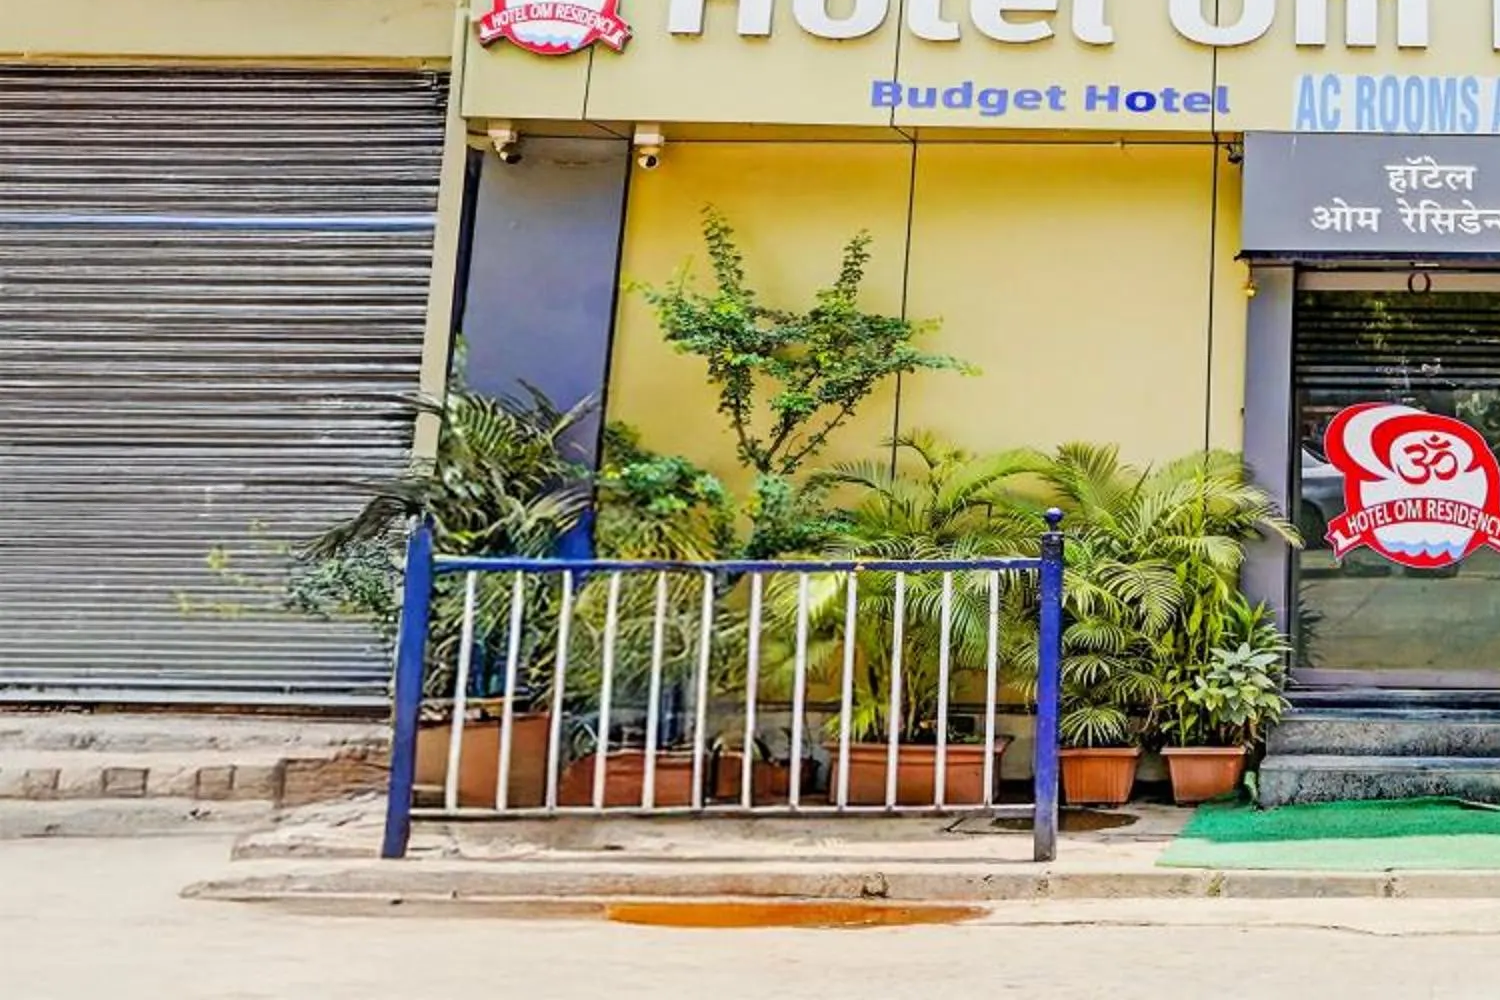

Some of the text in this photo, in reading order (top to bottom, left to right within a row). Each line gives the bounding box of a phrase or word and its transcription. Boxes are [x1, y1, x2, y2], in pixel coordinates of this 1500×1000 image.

[491, 3, 616, 34] HOTEL OM RESIDENCY
[870, 80, 1231, 117] Budget Hotel
[1299, 74, 1341, 131] AC
[1355, 74, 1480, 134] ROOMS
[1384, 156, 1478, 193] हॉटेल
[1311, 198, 1381, 233] ओम
[1347, 504, 1390, 536] HOTEL
[1394, 500, 1423, 520] OM
